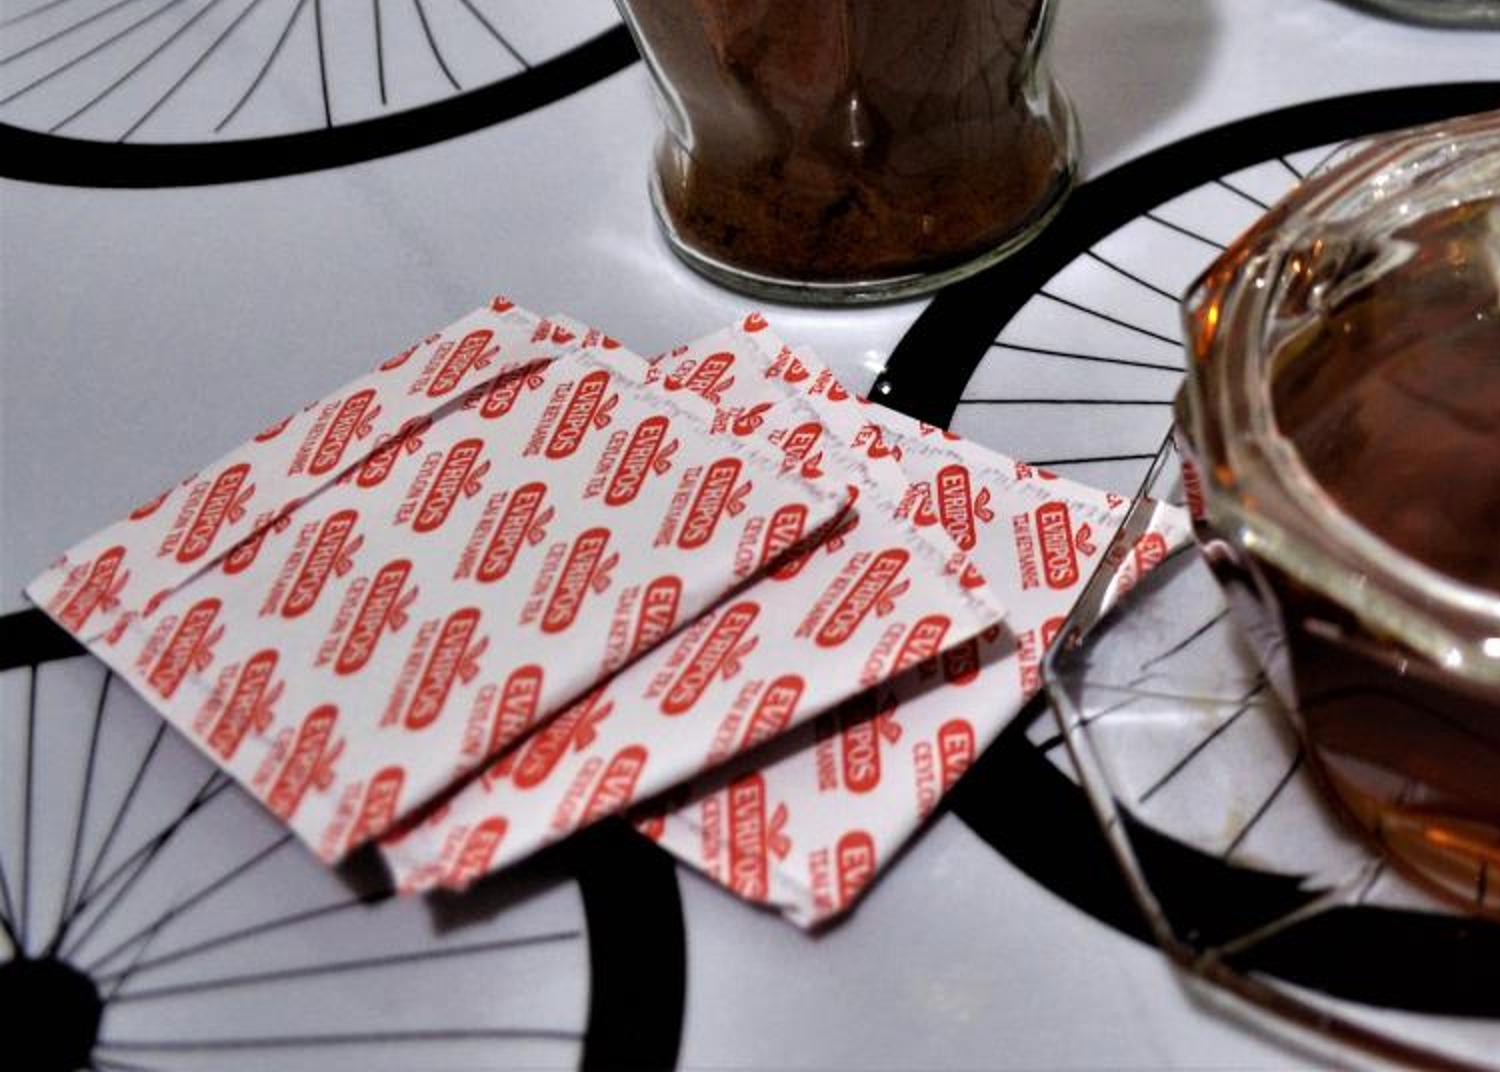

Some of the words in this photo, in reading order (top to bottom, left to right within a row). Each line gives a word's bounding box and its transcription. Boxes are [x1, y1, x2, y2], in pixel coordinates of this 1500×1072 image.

[317, 395, 372, 471] EVRIPOS
[551, 378, 604, 452] EVRIPOS
[594, 431, 628, 474] CEYLON
[418, 445, 480, 527] EVRIPOS
[583, 472, 610, 498] TEA
[611, 422, 664, 501] EVRIPOS
[182, 469, 245, 557] EVRIPOS
[484, 490, 541, 576] EVRIPOS
[684, 466, 736, 545] EVRIPOS
[1043, 509, 1074, 583] EVRIPOS
[288, 517, 353, 612] EVRIPOS
[548, 535, 605, 627] EVRIPOS
[822, 554, 901, 641] EVRIPOS
[342, 566, 407, 670] EVRIPOS
[668, 609, 753, 708] EVRIPOS
